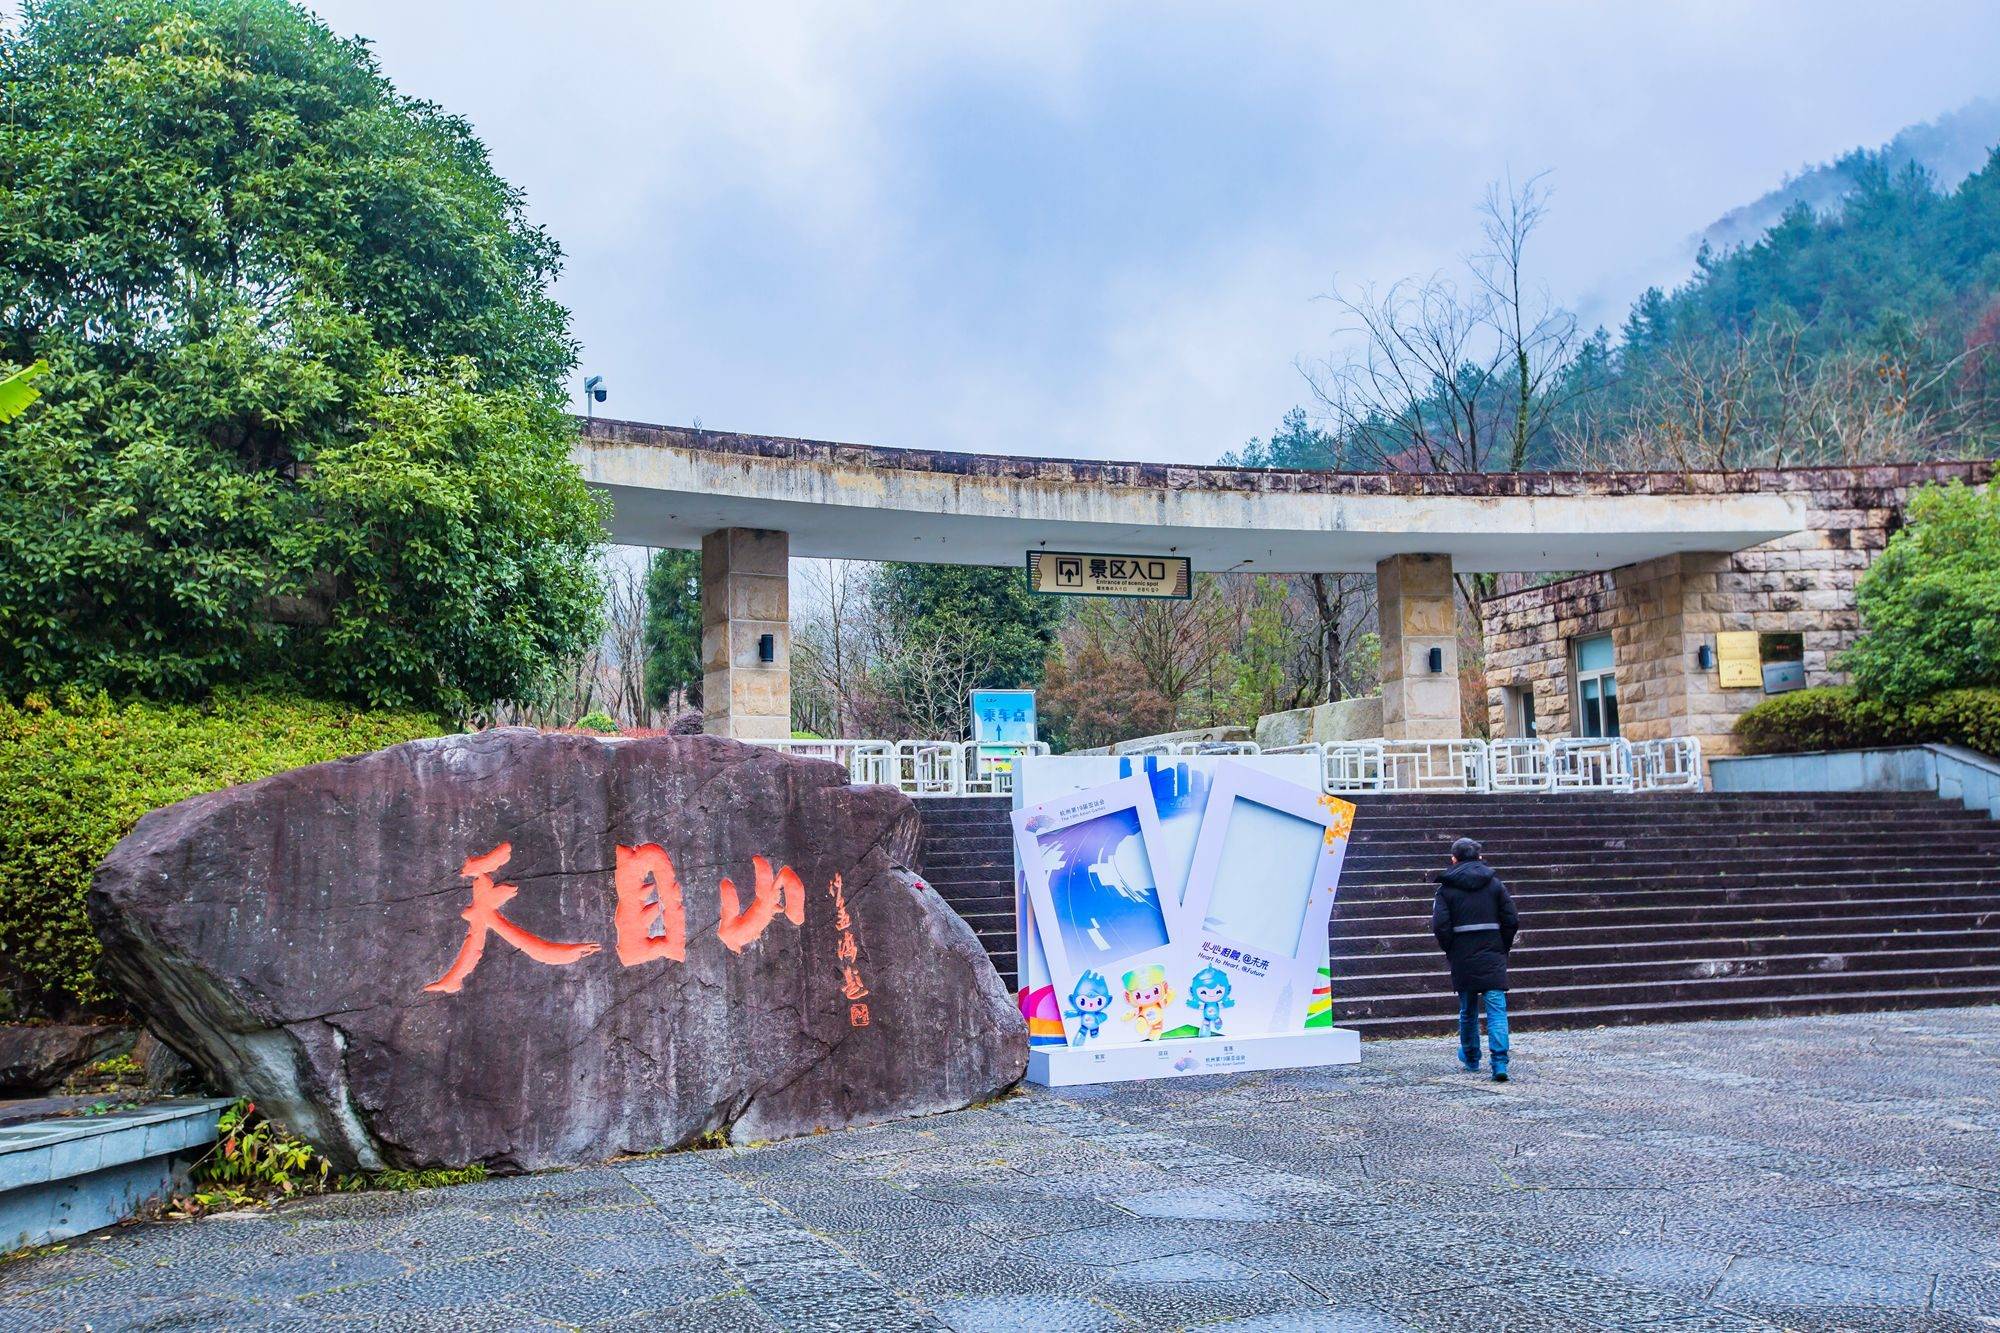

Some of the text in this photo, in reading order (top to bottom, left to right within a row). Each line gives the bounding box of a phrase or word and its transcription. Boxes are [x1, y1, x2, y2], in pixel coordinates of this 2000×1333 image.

[1089, 559, 1165, 580] 景区入口
[1198, 952, 1214, 961] Heart
